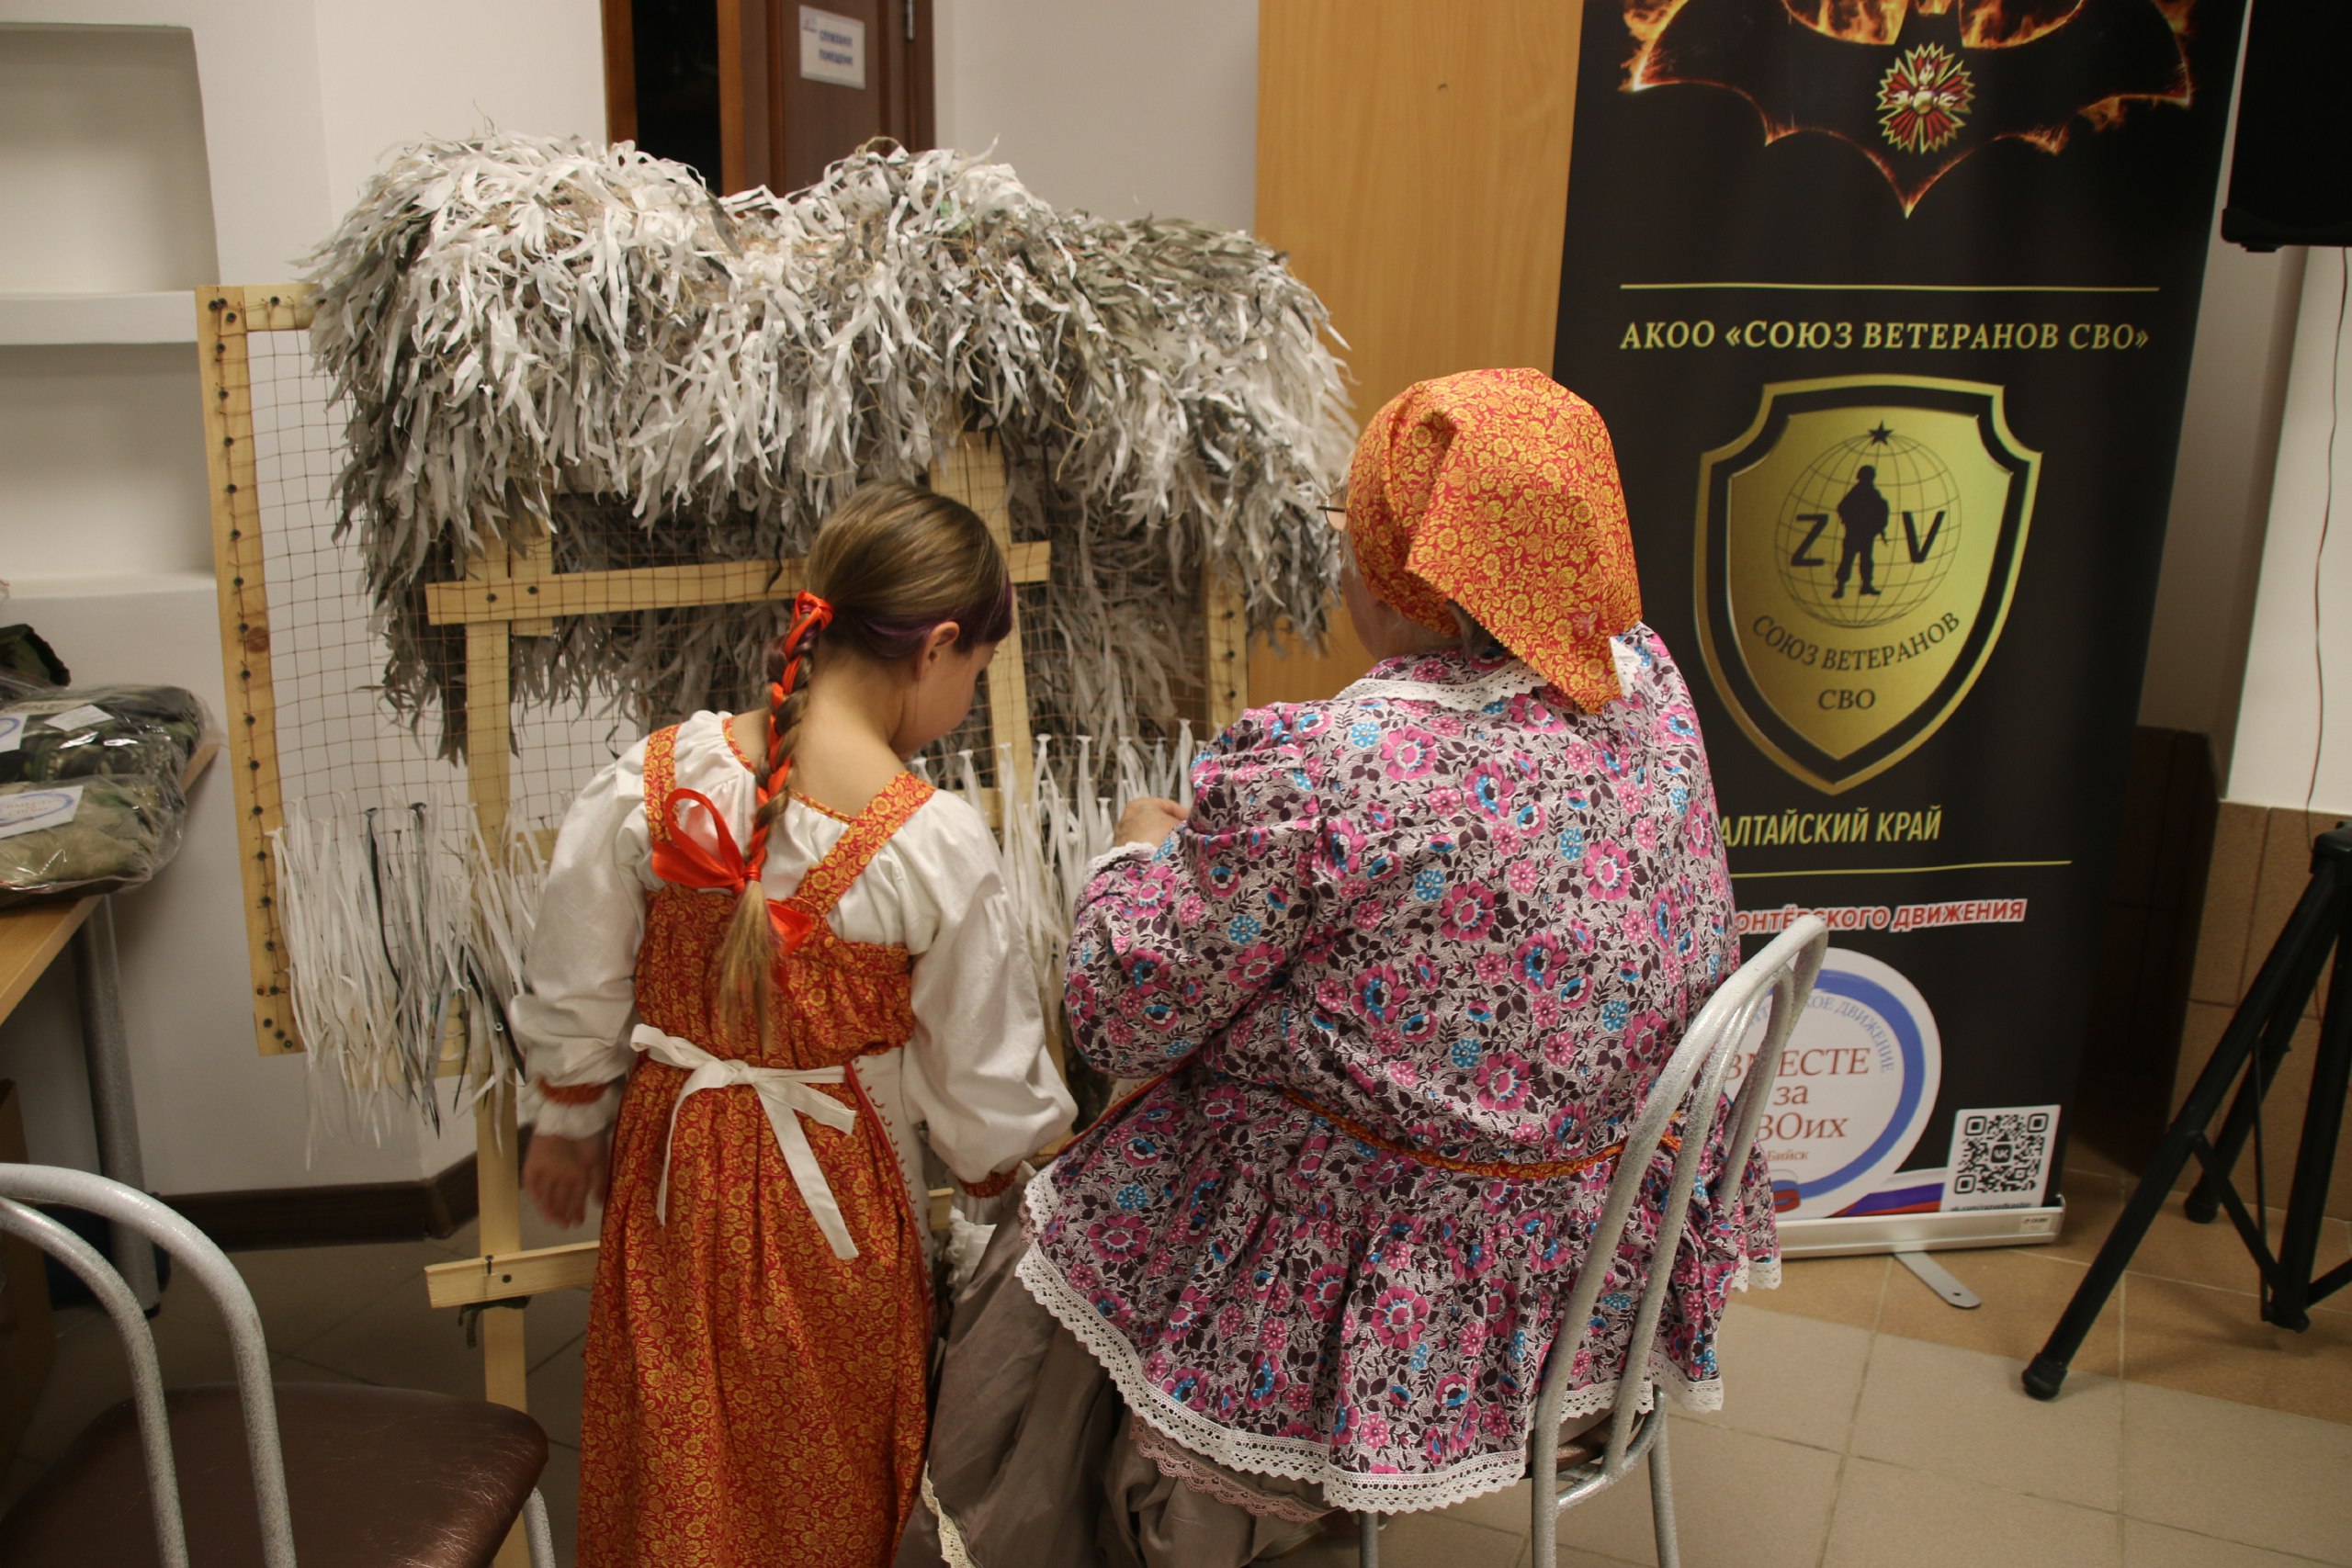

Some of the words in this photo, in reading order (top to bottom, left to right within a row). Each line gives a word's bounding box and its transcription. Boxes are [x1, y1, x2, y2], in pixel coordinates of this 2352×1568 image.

[1620, 321, 1715, 349] АКОО
[1725, 321, 1853, 349] «СОЮЗ
[1861, 322, 2059, 349] ВЕТЕРАНОВ
[2069, 323, 2149, 349] СВО»
[1791, 513, 1829, 567] Z
[1902, 511, 1946, 563] V
[1753, 615, 1819, 666] СОЮЗ
[1821, 612, 1961, 671] ВЕТЕРАНОВ
[1818, 689, 1876, 710] СВО
[1720, 807, 1869, 847] АЛТАЙСКИЙ
[1875, 805, 1941, 842] КРАЙ
[1890, 899, 2027, 932] ДВИЖЕНИЯ
[1727, 1047, 1870, 1080] ВЕСТЕ
[1773, 1085, 1809, 1106] за
[1756, 1112, 1849, 1141] ВОих
[1768, 1149, 1809, 1161] Бийск
